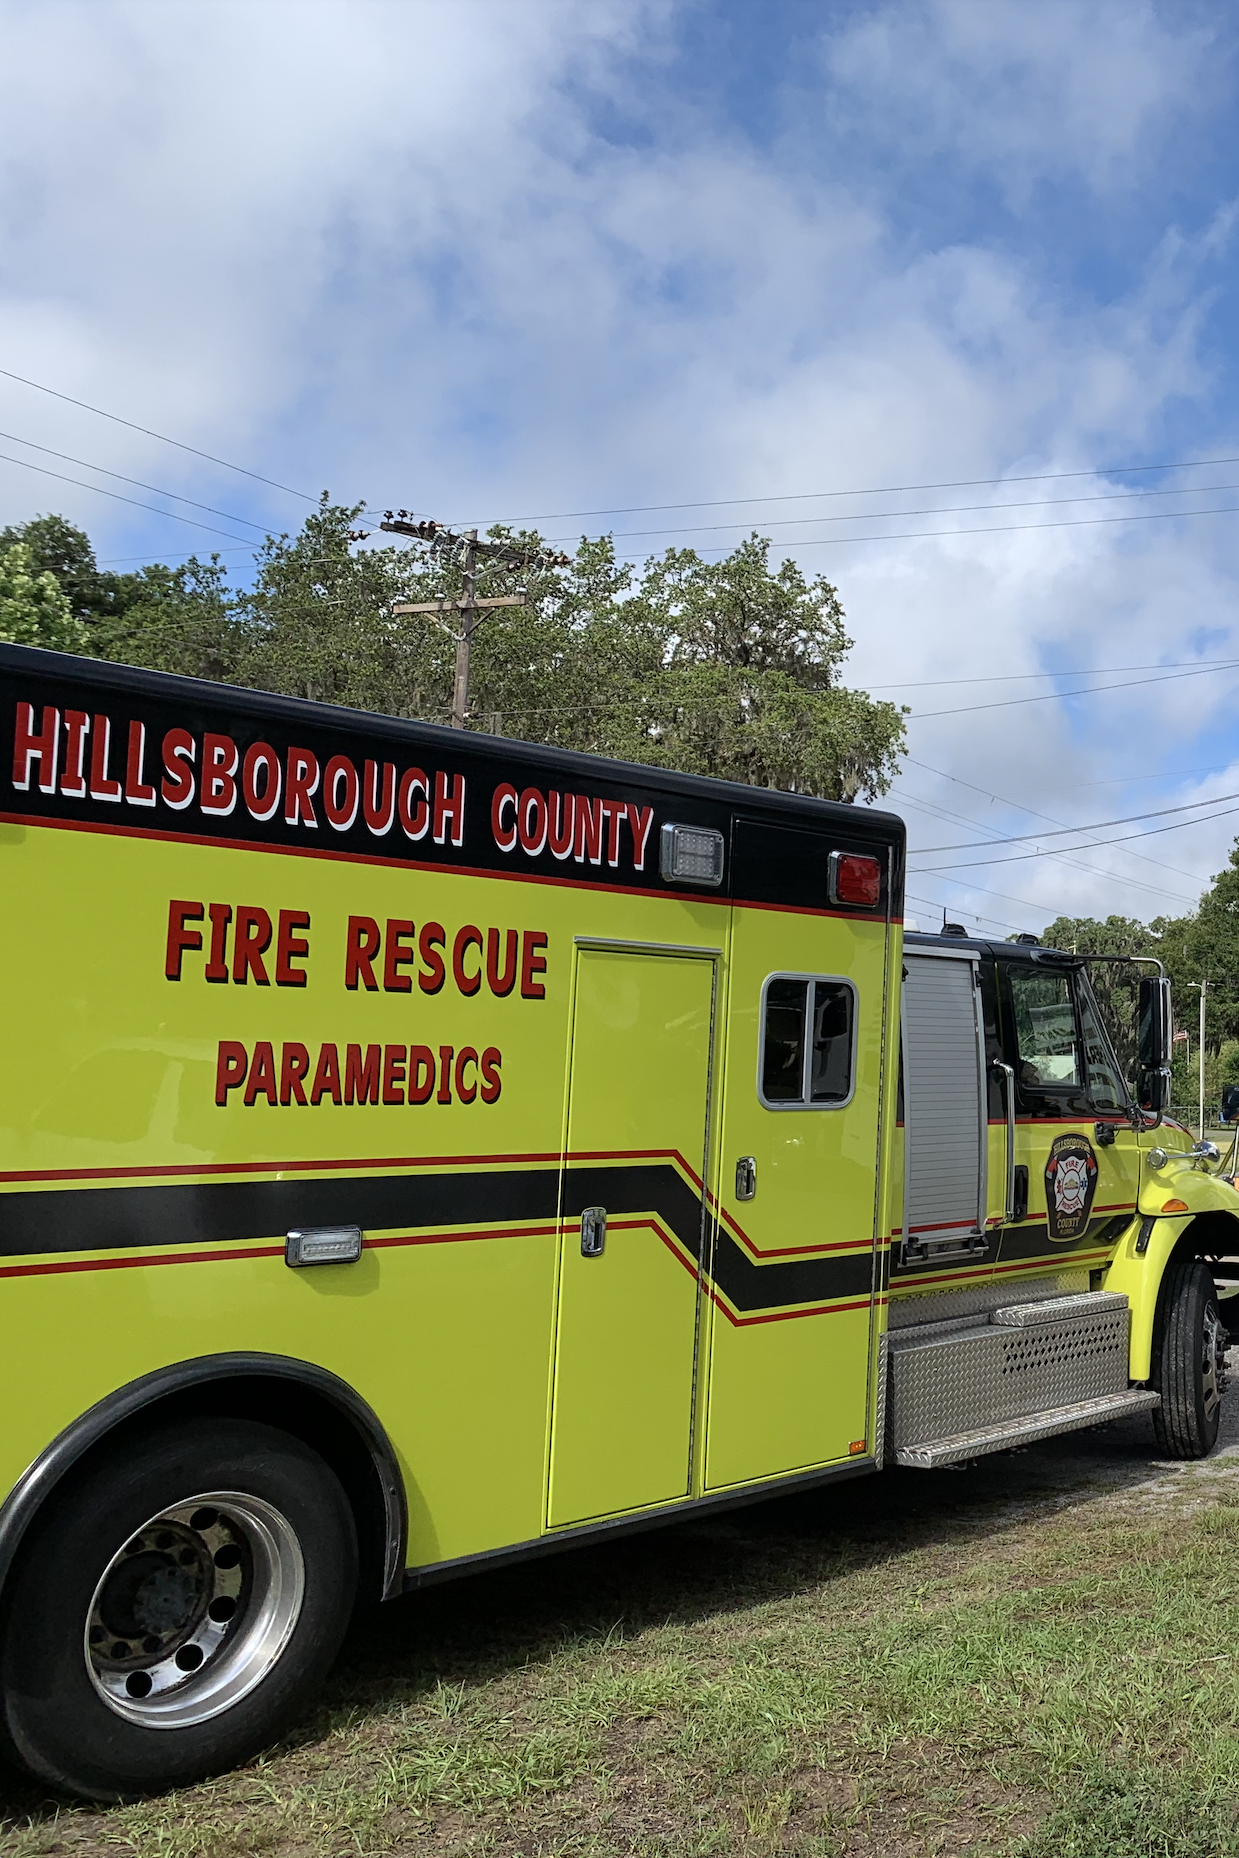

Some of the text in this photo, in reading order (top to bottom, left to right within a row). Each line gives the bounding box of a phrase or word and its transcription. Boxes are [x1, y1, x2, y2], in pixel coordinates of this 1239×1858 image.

[12, 702, 655, 871] HILLSBOROUGH COUNTY
[165, 900, 547, 999] FIRE RESCUE
[215, 1040, 502, 1107] PARAMEDICS
[1065, 1160, 1079, 1169] FIRE
[1057, 1217, 1081, 1229] COUNTY
